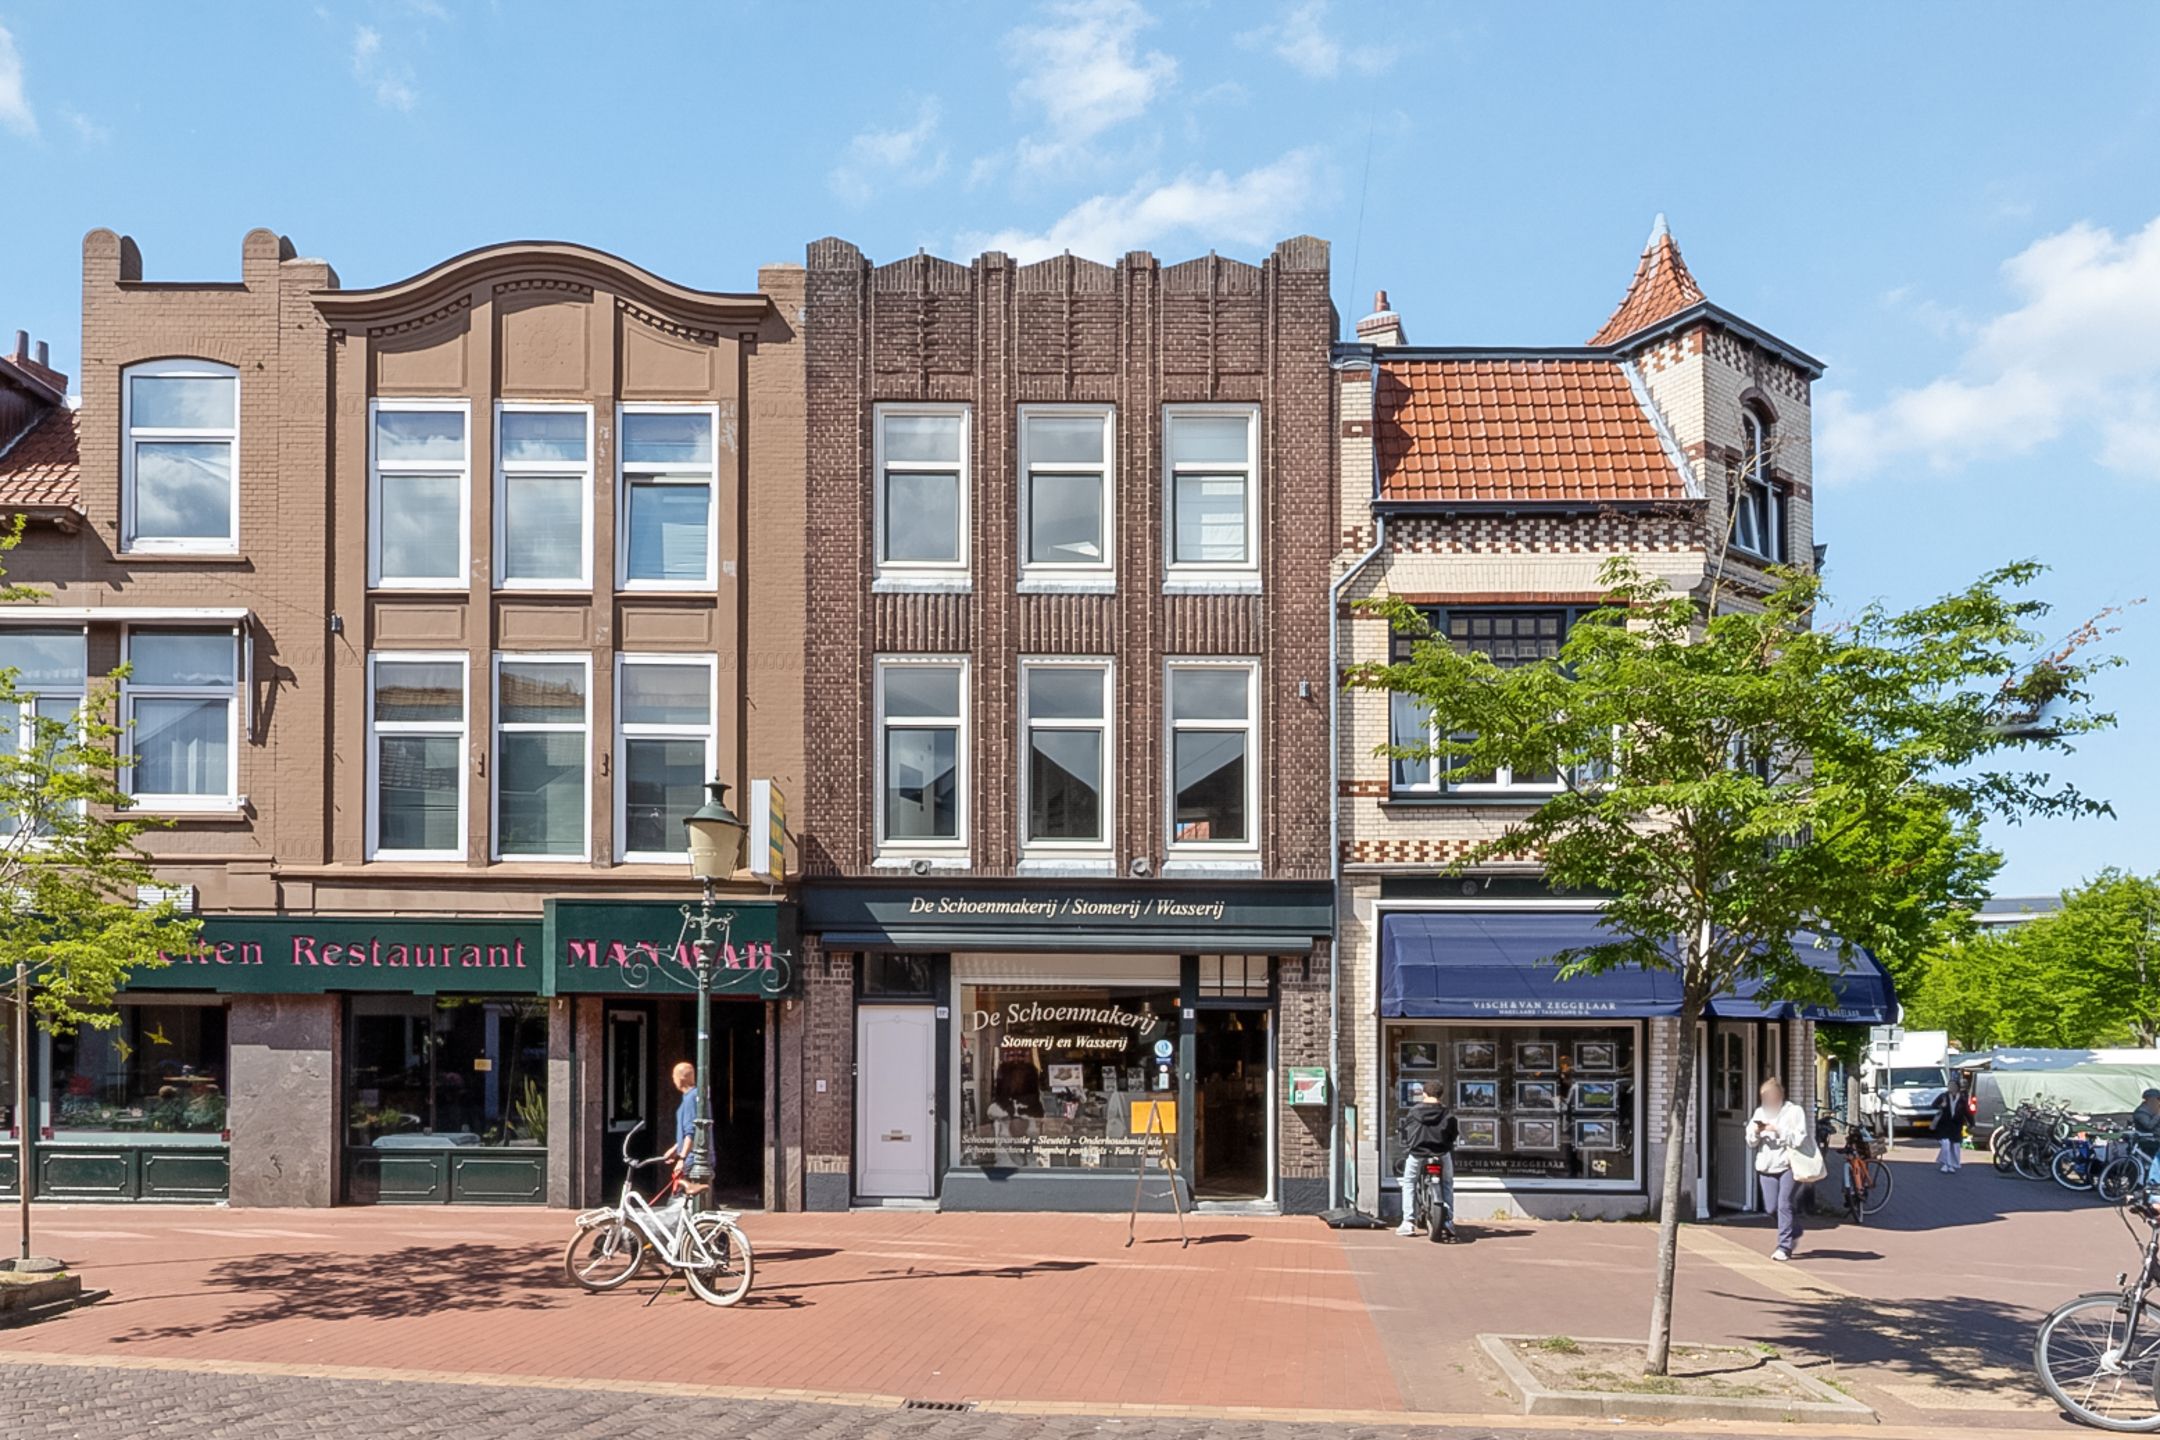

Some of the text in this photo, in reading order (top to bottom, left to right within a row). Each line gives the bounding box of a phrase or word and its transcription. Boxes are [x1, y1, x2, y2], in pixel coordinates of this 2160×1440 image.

[909, 896, 935, 913] De
[938, 897, 1058, 918] Schoenmakerij
[1071, 898, 1142, 919] Stomerij
[1156, 899, 1226, 920] Wasserij
[290, 935, 527, 967] Restaurant
[567, 938, 659, 969] MAN
[1547, 1001, 1616, 1010] ZEGGELAAR
[973, 1002, 1159, 1036] De Schoenmakerij
[1001, 1035, 1128, 1051] Stomerij en Wasserij
[1038, 1135, 1071, 1144] Sleutels
